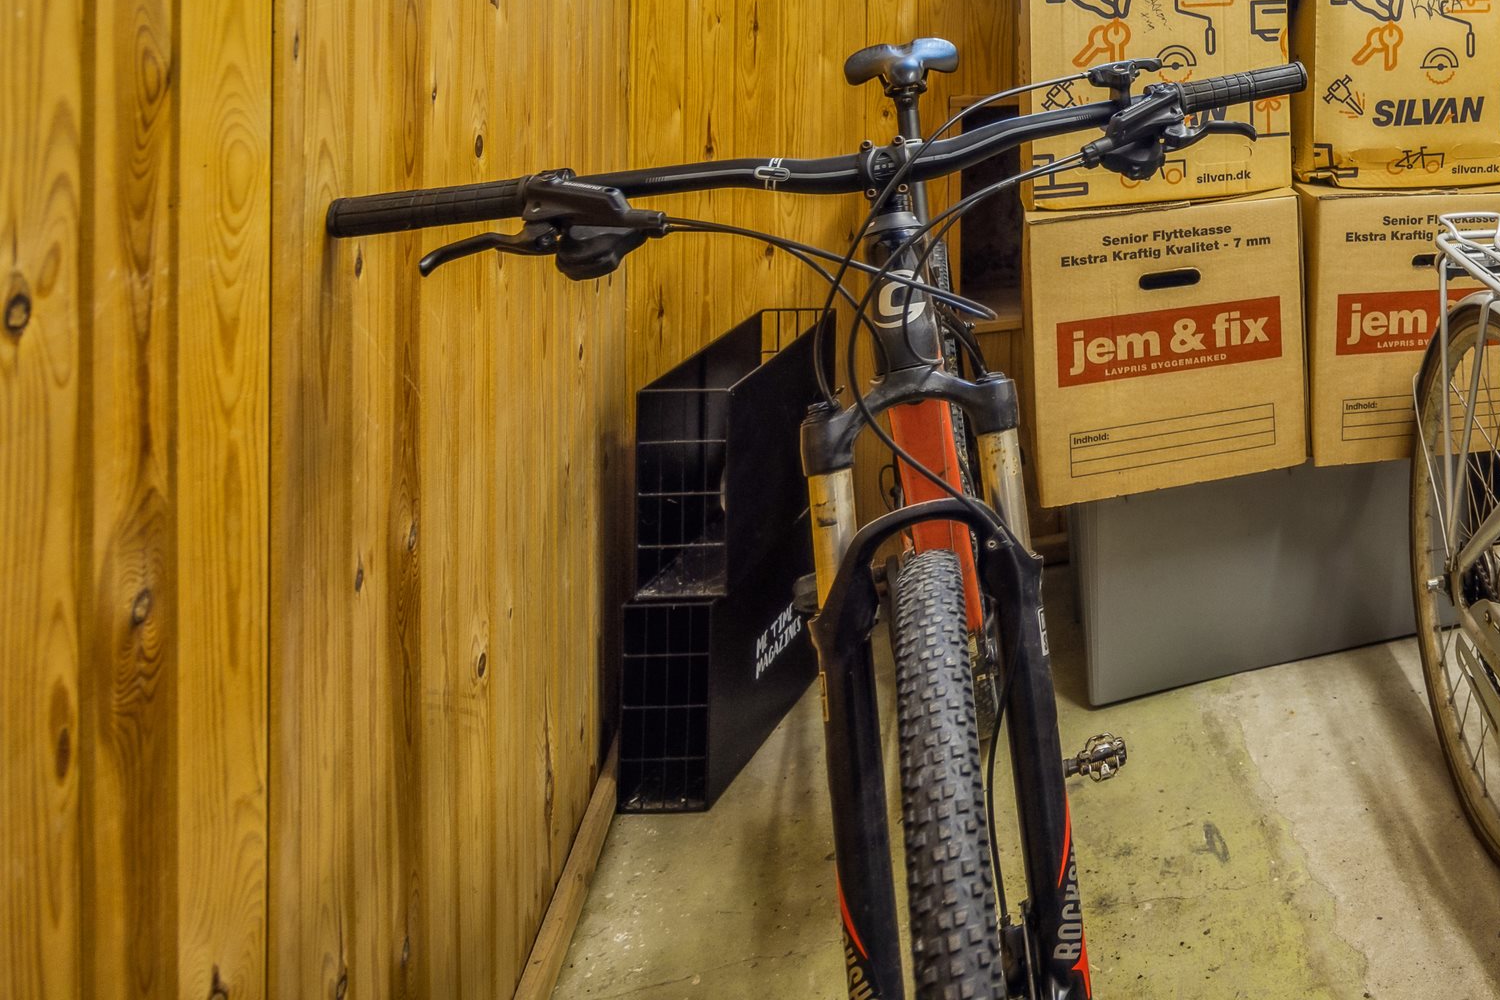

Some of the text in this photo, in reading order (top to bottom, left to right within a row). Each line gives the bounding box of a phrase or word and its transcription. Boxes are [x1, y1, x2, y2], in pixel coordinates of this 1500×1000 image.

[1372, 96, 1485, 127] SILVAN
[1196, 170, 1251, 184] silvan.dk
[1451, 164, 1500, 175] silvan.dk
[1382, 215, 1423, 226] Senior
[1102, 225, 1232, 247] Senior Flyttekasse
[1345, 231, 1387, 243] Ekstra
[1390, 230, 1434, 242] Kraftig
[1060, 254, 1108, 268] Ekstra
[1112, 247, 1161, 262] Kraftig
[1165, 241, 1220, 256] Kvalitet
[1233, 237, 1242, 248] 7
[1246, 236, 1271, 247] mm
[1346, 302, 1428, 345] jem
[1069, 310, 1270, 376] jem & fix
[1377, 339, 1415, 349] LAVPRIS
[1104, 353, 1228, 377] LAVPRIS BYGGEMARKED
[1345, 400, 1378, 411] Indhold:
[1073, 432, 1110, 445] Indhold:
[756, 601, 794, 660] ME TIME
[755, 615, 801, 680] MAGAZINES
